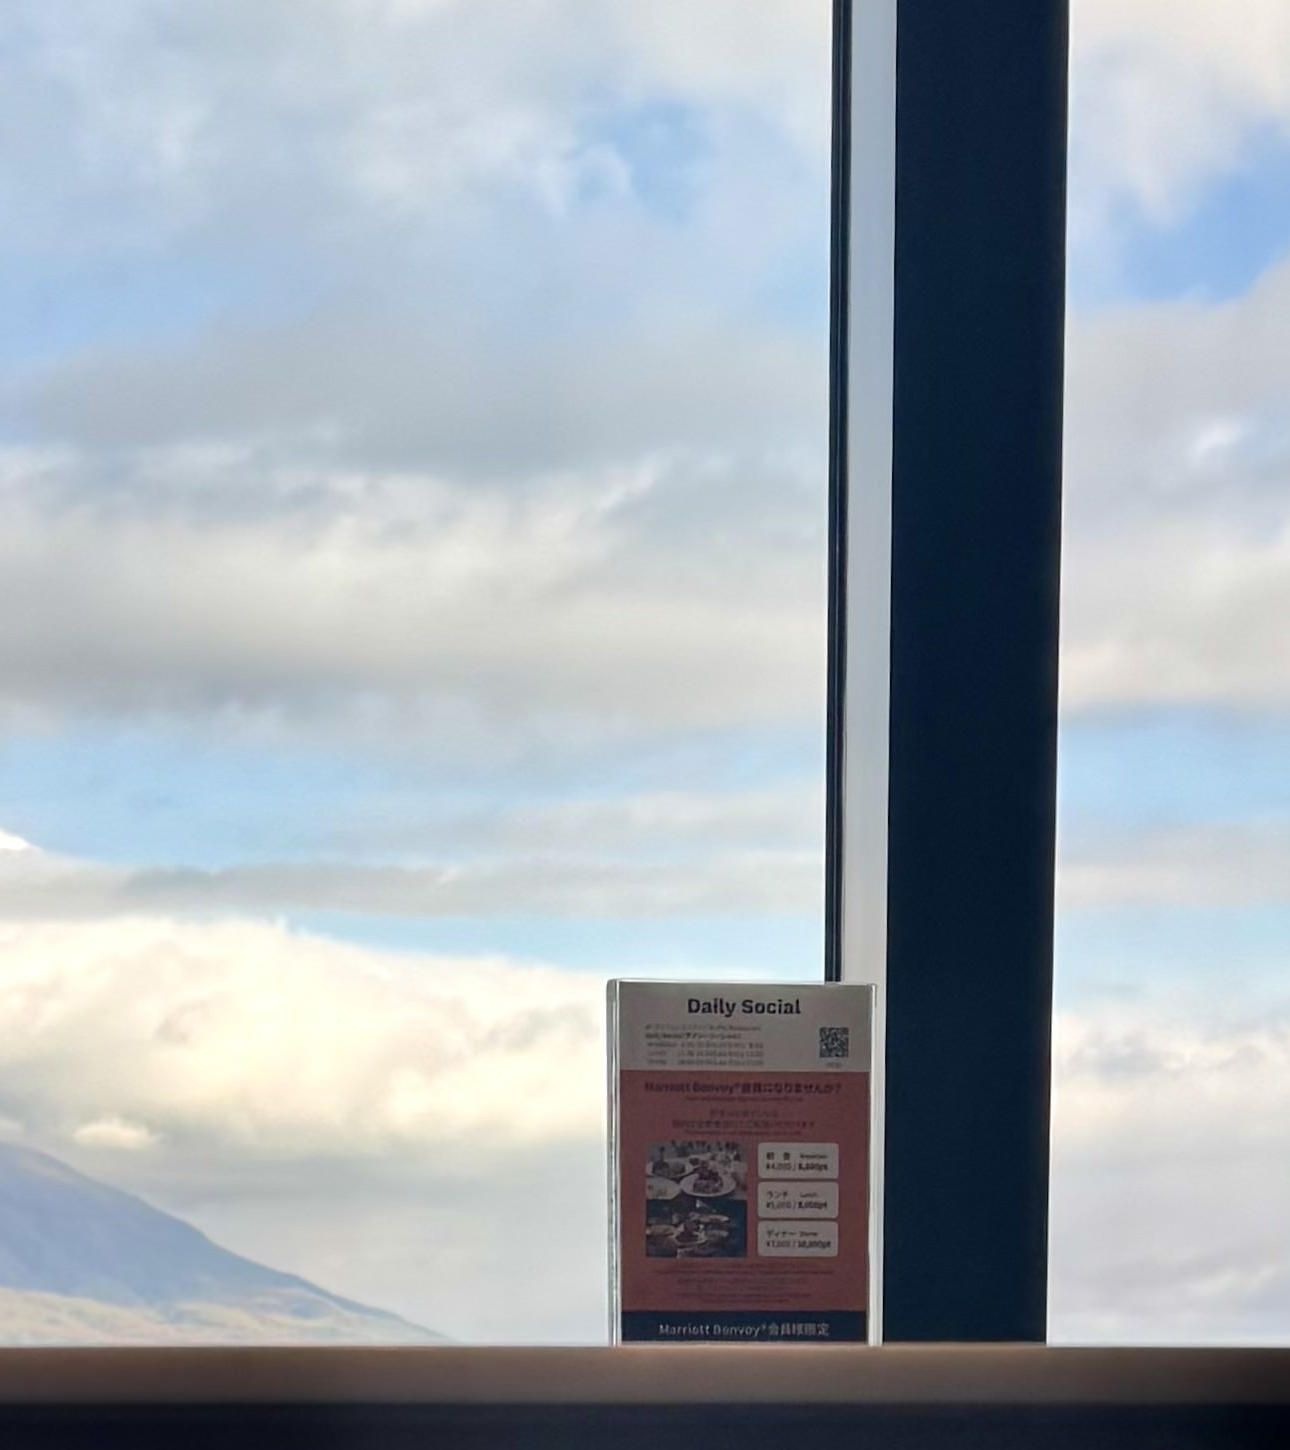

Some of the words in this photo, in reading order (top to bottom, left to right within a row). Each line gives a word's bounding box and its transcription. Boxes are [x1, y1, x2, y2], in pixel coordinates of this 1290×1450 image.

[687, 998, 736, 1018] Daily
[741, 998, 801, 1015] Social
[659, 1323, 710, 1335] Marriott
